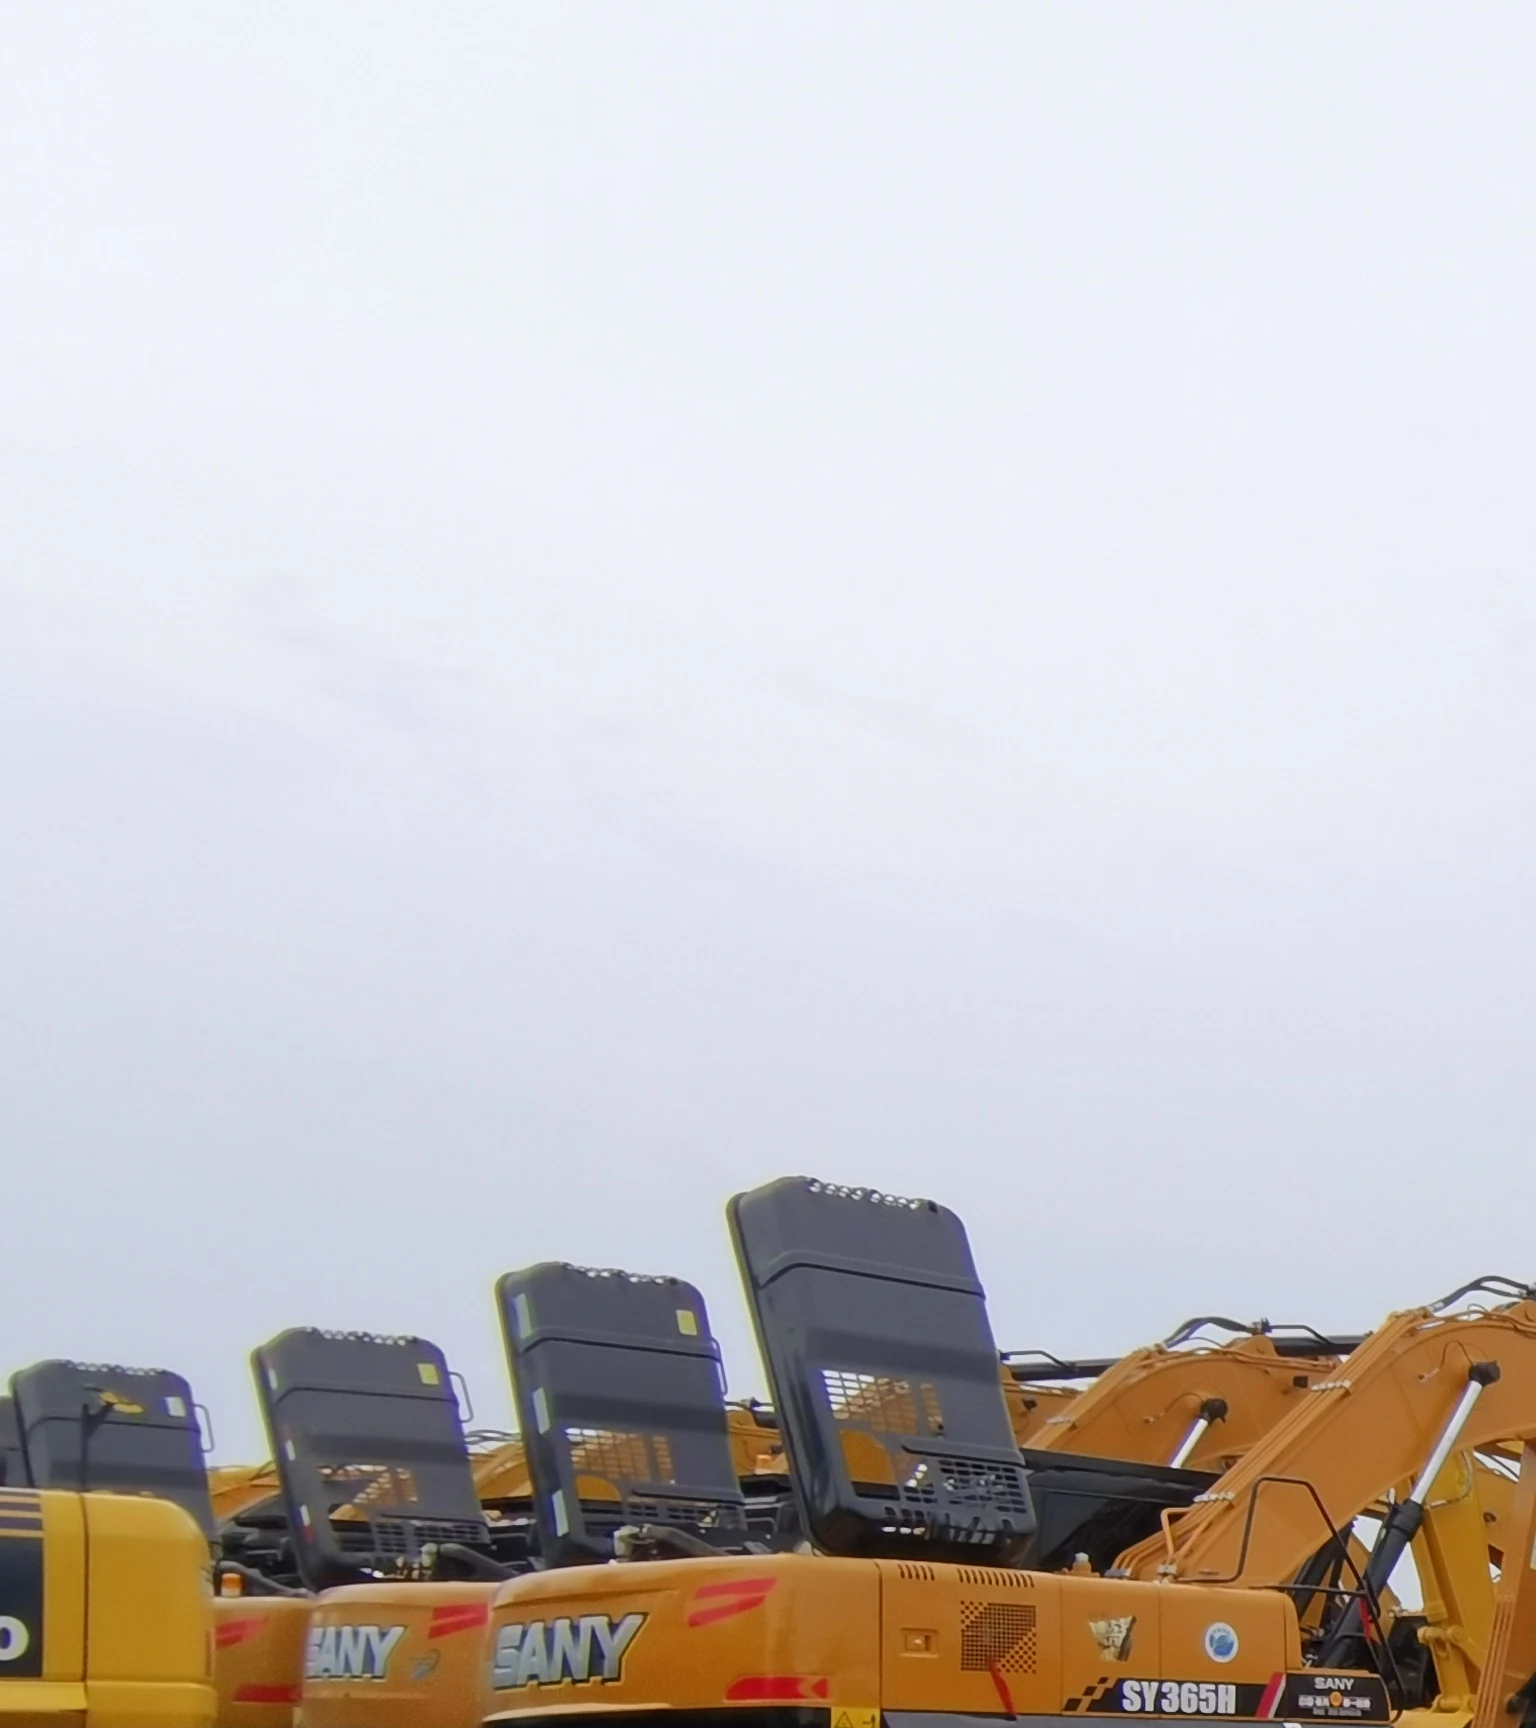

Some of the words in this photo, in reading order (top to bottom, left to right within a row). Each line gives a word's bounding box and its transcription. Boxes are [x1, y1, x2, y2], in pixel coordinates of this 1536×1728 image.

[306, 1624, 408, 1680] SANY
[494, 1612, 649, 1690] SANY
[1121, 1680, 1236, 1714] SY365H
[1314, 1677, 1354, 1690] SANY
